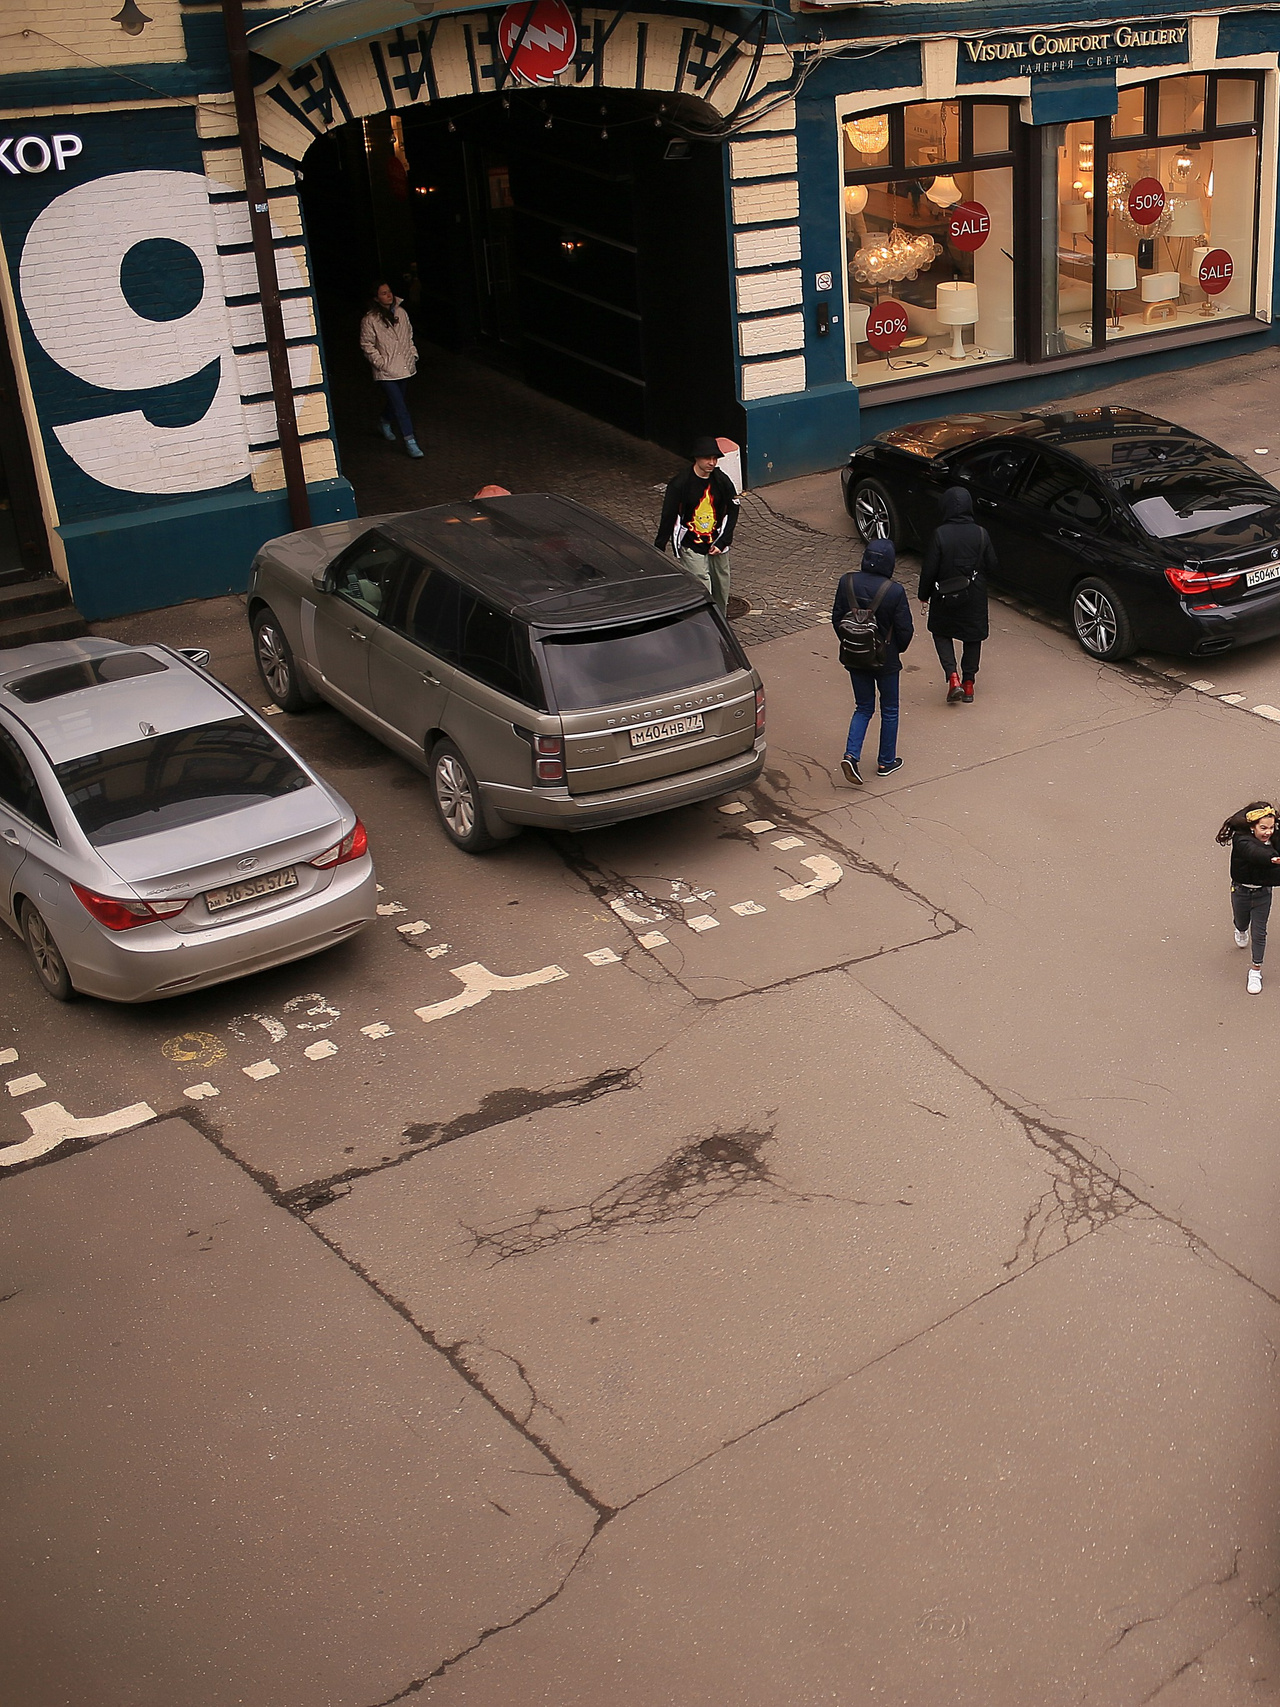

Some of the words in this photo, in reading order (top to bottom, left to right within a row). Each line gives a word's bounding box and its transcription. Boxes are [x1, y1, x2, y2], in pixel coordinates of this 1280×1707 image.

[964, 40, 1027, 62] VISUAL
[1029, 34, 1111, 56] COMFORT
[1114, 26, 1187, 48] GALLERY
[1019, 59, 1074, 75] ГАЛЕРЕЯ
[1086, 54, 1129, 67] СВЕТА
[1130, 193, 1164, 210] -50%
[951, 217, 989, 236] SALE
[1200, 263, 1232, 281] SALE
[19, 169, 313, 494] 9
[868, 318, 907, 336] -50%
[606, 708, 664, 726] RANGE
[672, 692, 726, 711] ROVER
[686, 715, 699, 728] 77
